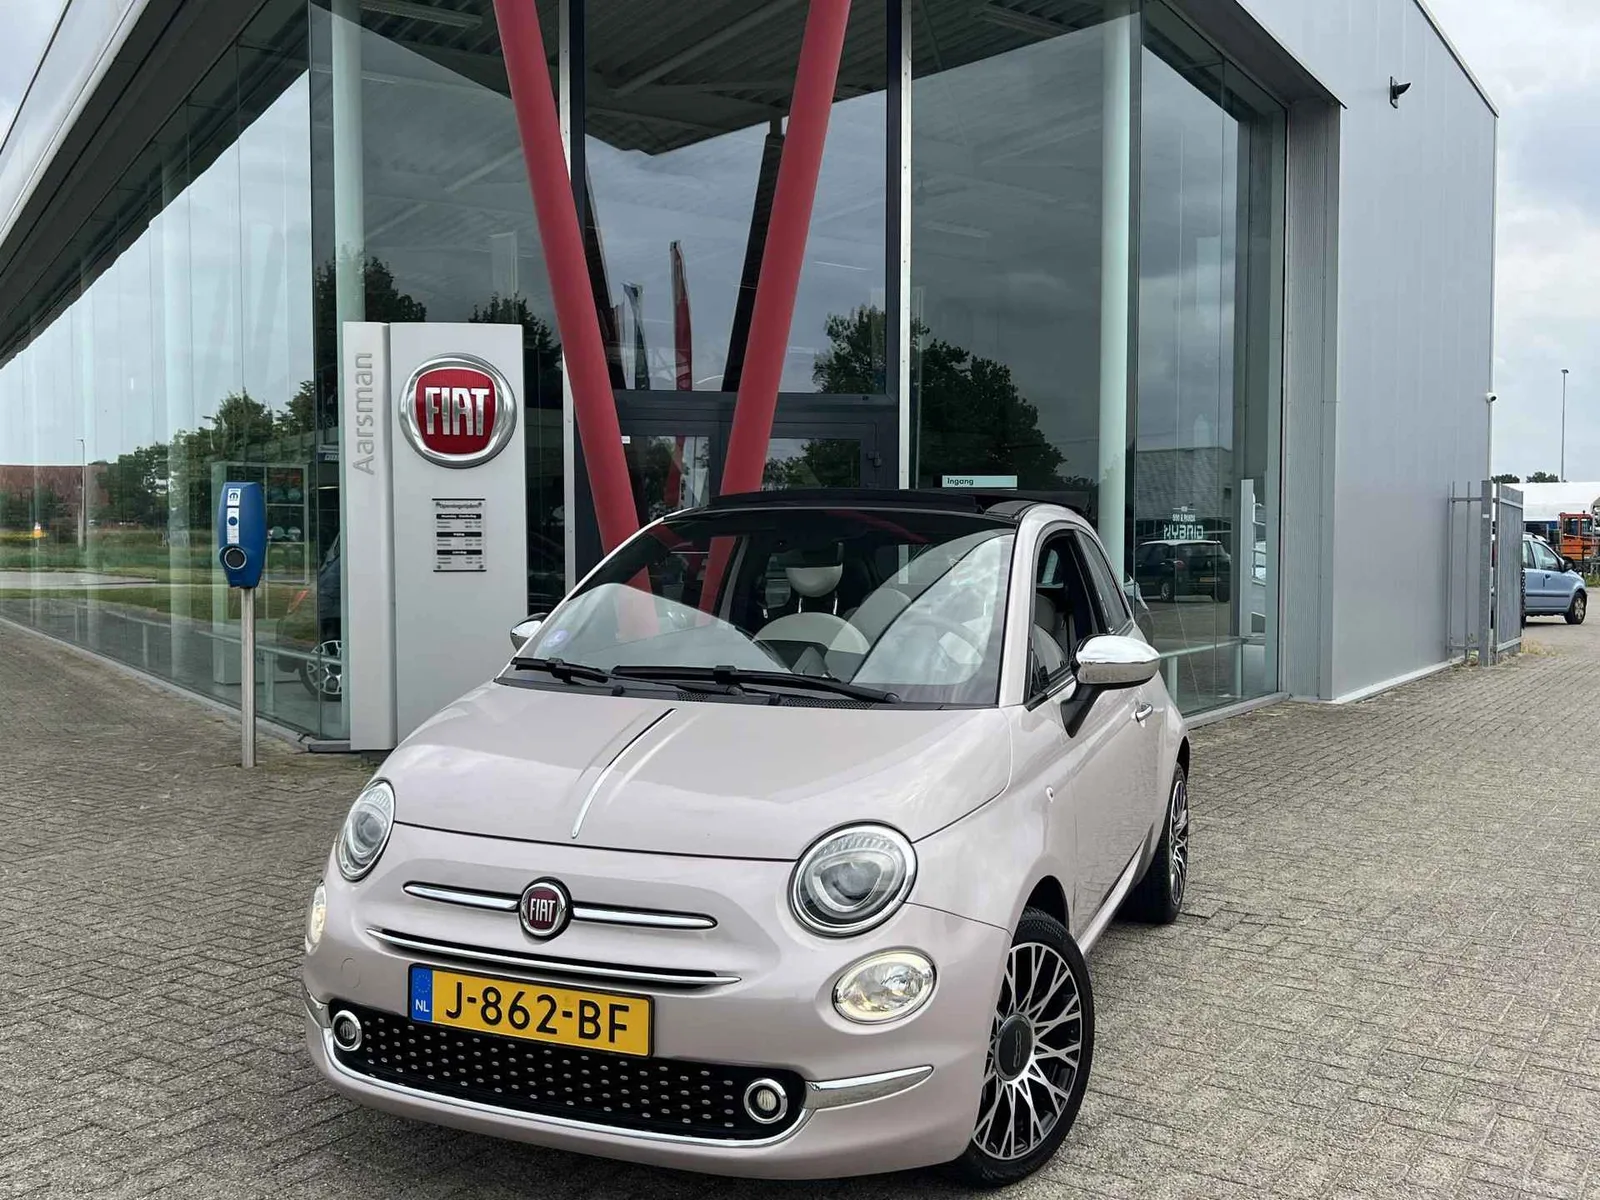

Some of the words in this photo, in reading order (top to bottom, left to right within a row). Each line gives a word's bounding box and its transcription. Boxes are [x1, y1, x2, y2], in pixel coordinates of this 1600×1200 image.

[352, 352, 375, 476] Aarsman
[425, 387, 490, 436] FIAT
[947, 477, 974, 486] Ingang
[530, 897, 556, 922] FIAT
[415, 999, 430, 1013] NL
[446, 981, 630, 1043] J-862-BF
